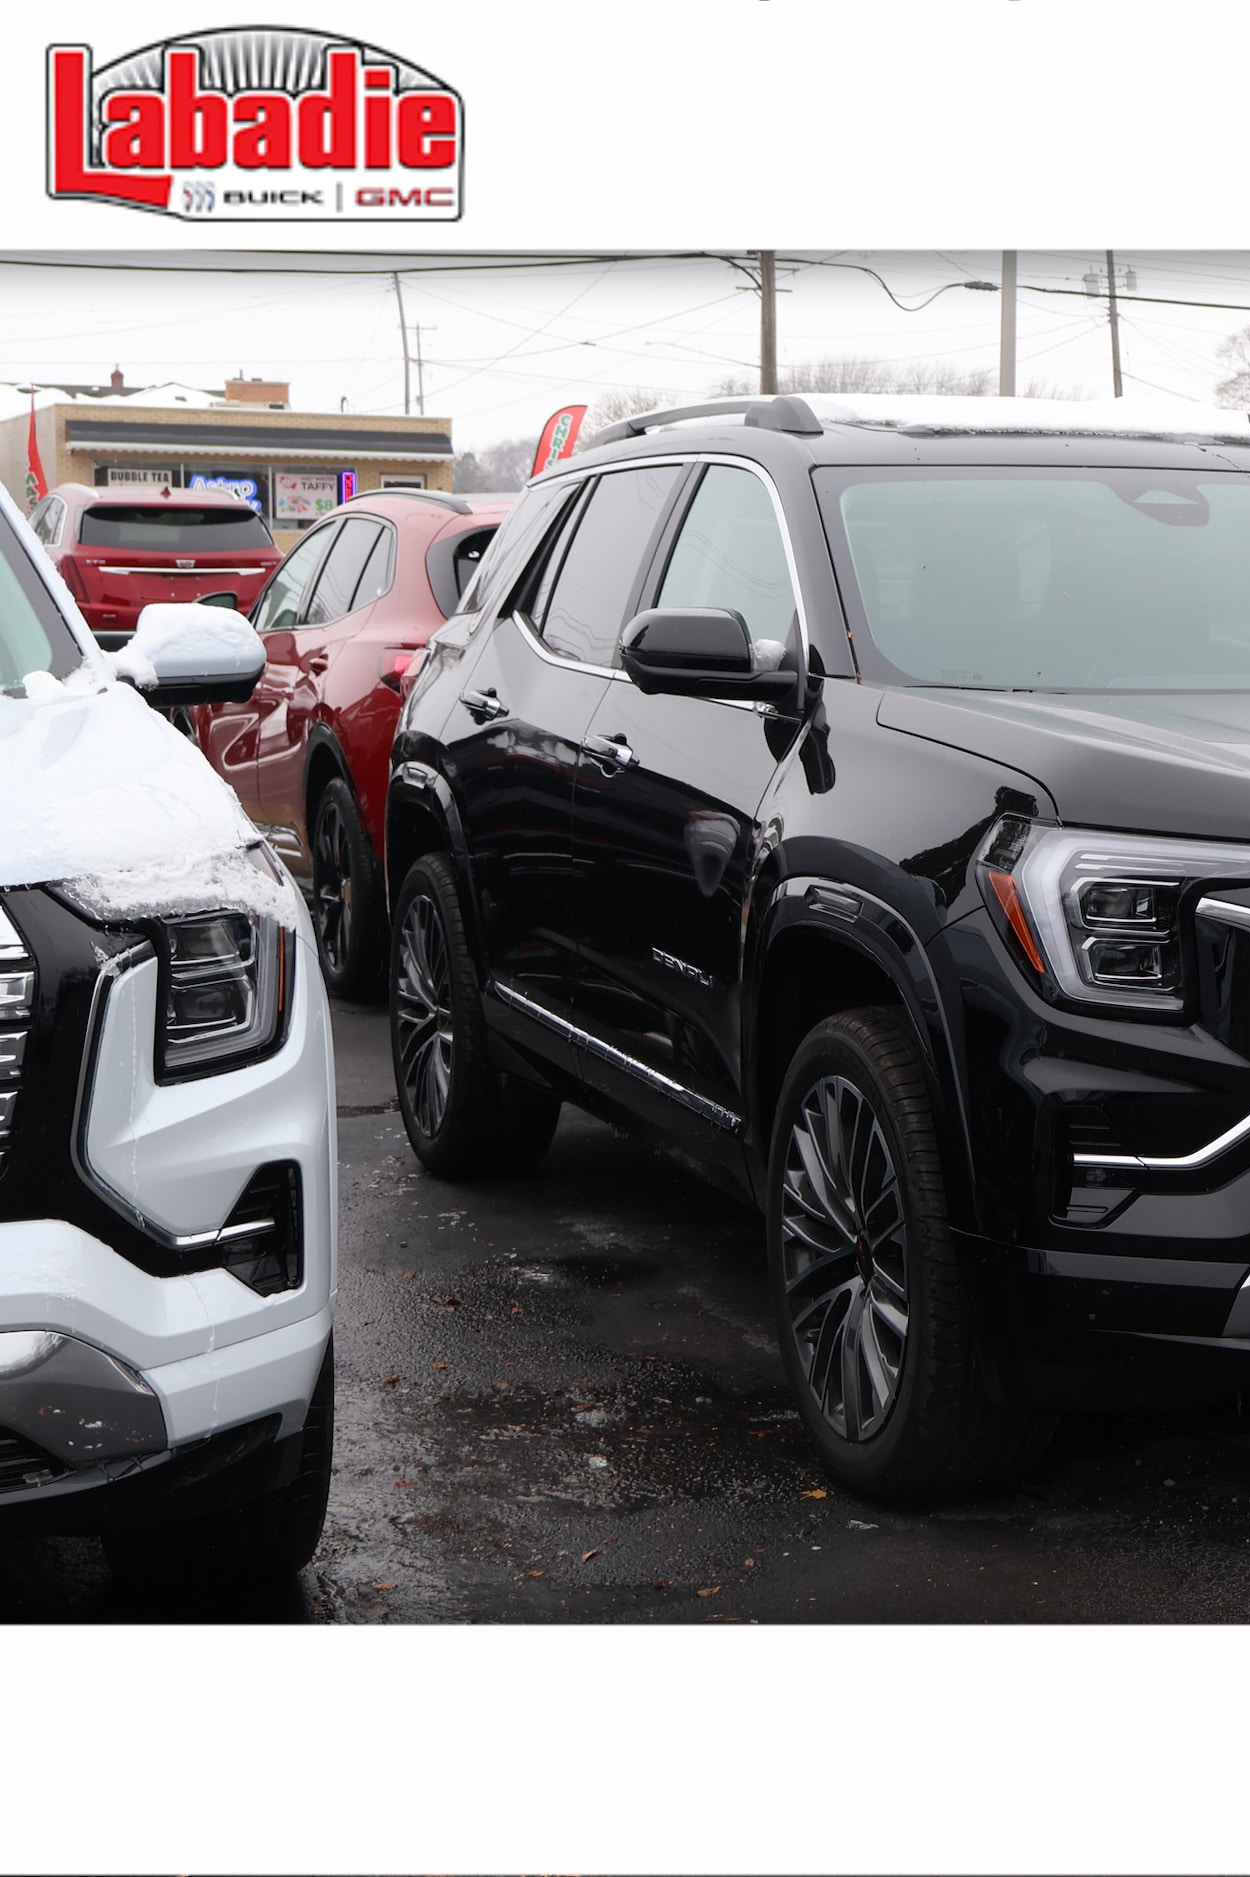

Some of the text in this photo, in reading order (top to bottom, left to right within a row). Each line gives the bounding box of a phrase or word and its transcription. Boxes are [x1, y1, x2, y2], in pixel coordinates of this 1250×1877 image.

[110, 471, 169, 482] BUBBLE TEA
[301, 482, 336, 491] TAFFY
[315, 499, 334, 511] $8
[652, 947, 714, 989] DENALI
